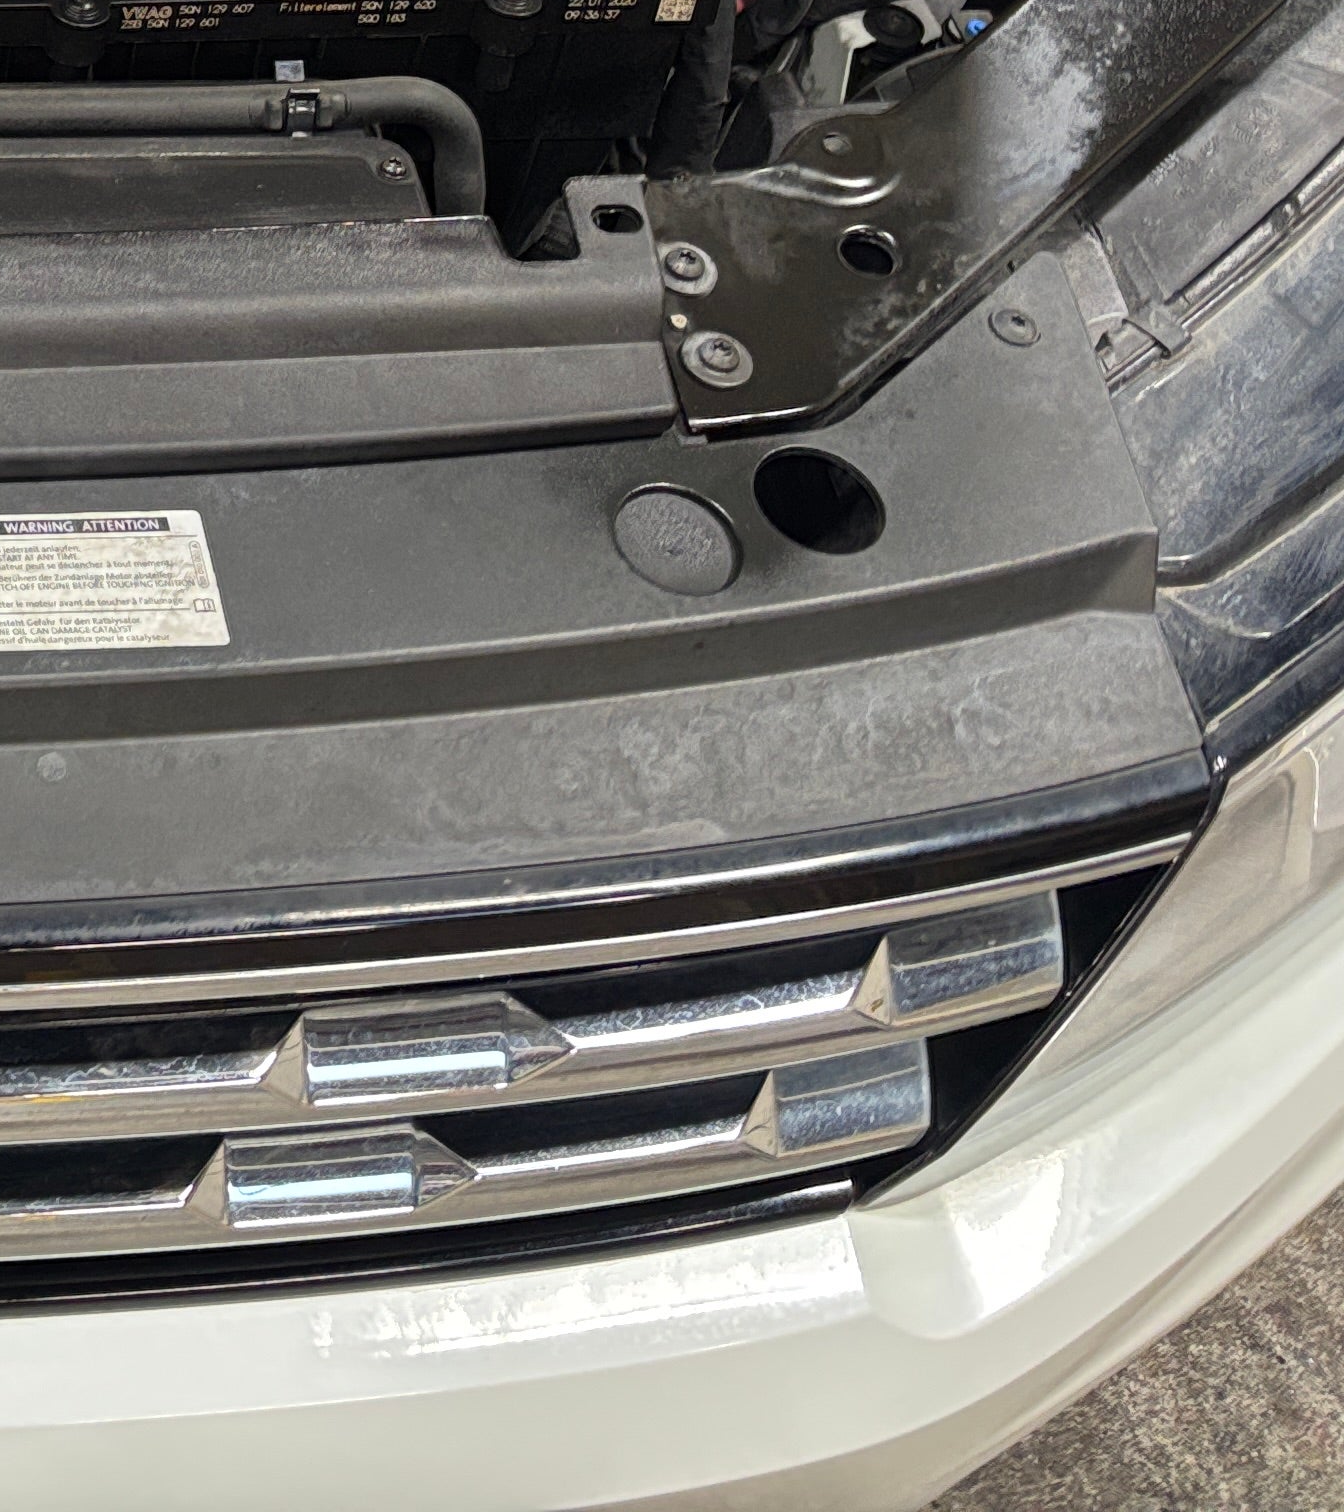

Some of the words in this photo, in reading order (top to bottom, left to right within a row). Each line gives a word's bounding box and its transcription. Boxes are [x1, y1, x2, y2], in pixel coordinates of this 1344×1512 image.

[208, 4, 227, 14] 129
[232, 3, 255, 14] 607
[279, 1, 357, 14] Filterelement
[390, 0, 410, 10] 129
[413, 0, 437, 10] 620
[176, 18, 195, 28] 129
[199, 18, 220, 27] 601
[386, 13, 407, 23] 183
[3, 521, 74, 534] WARNING
[81, 518, 161, 531] ATTENTION
[3, 546, 40, 557] jederzeit
[37, 553, 54, 561] ANY
[25, 563, 45, 572] peut
[114, 560, 131, 568] tout
[20, 583, 35, 591] OFF
[37, 582, 71, 590] ENGINE
[72, 580, 104, 589] BEFORE
[107, 580, 153, 589] TOUCHING
[26, 599, 56, 607] moteur
[59, 599, 83, 607] avant
[85, 598, 95, 606] de
[97, 597, 130, 606] toucher
[59, 617, 72, 625] für
[52, 626, 90, 634] DAMAGE
[92, 625, 132, 633] CATALYST
[48, 635, 93, 644] dangereux
[95, 635, 115, 643] pour
